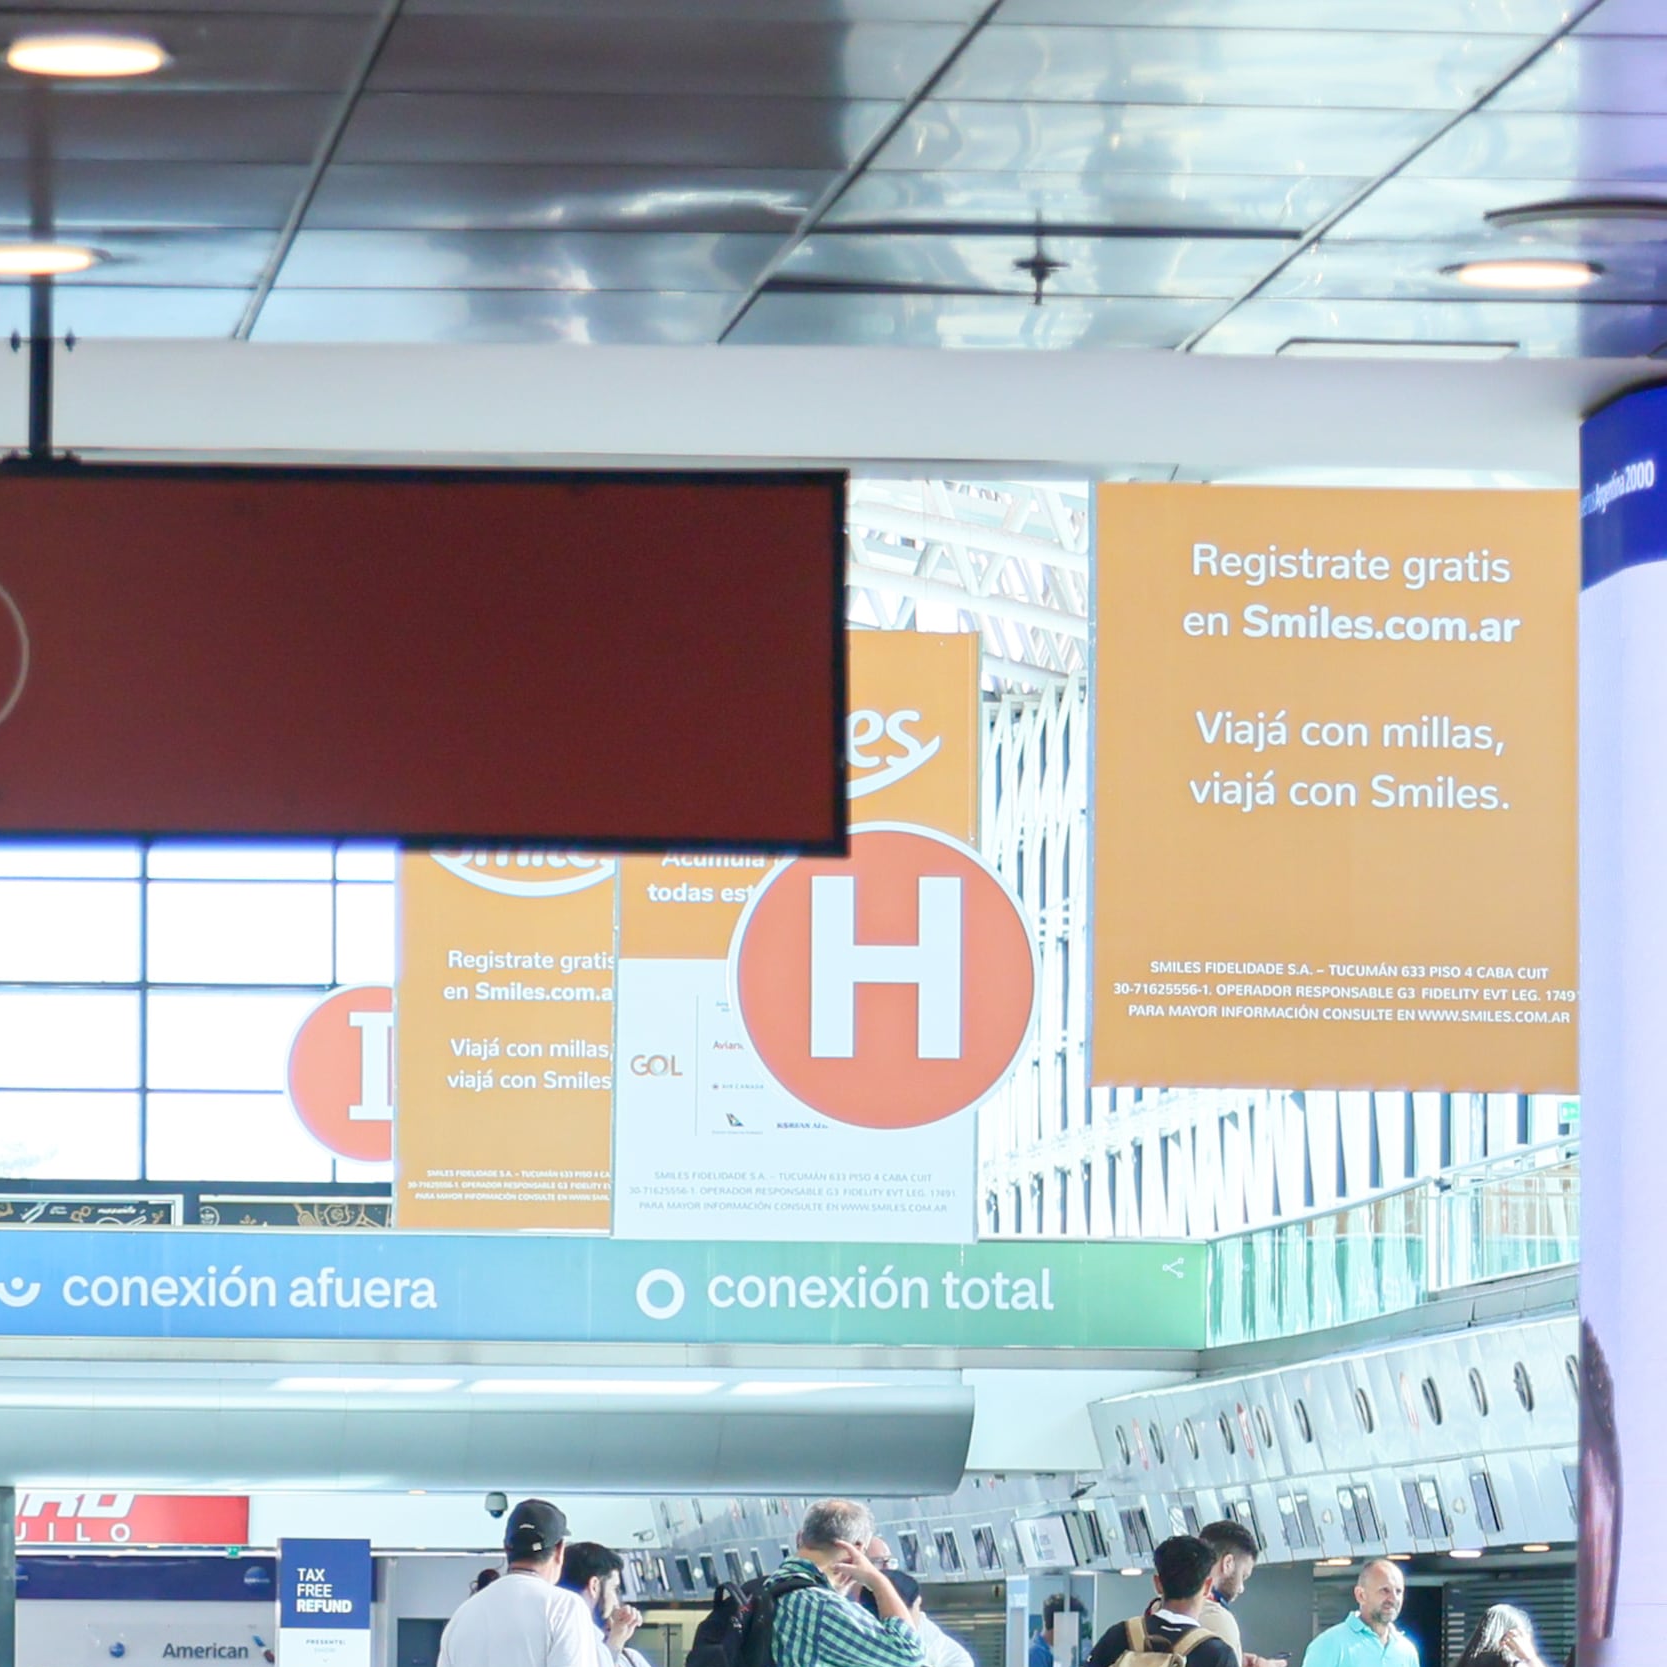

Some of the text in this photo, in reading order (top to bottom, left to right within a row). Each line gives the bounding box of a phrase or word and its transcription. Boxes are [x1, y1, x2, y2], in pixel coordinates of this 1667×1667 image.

[1192, 543, 1510, 589] Registrate gratis
[1183, 605, 1521, 642] en Smiles.com.ar
[1196, 711, 1505, 756] Viajá con millas,
[1190, 770, 1510, 811] viajá con Smiles.
[647, 883, 714, 902] todas
[448, 950, 553, 973] Registrate
[811, 875, 962, 1059] H
[1150, 961, 1549, 979] SMILES FIDELIDADE S.A. TUCUMÁN 633 PISO 4 CABA CUIT
[443, 985, 468, 1000] en
[1128, 1004, 1570, 1023] PARA MAYOR INFORMACIÓN CONSULTE EN WWW.SMILES.COM.AR
[451, 1037, 542, 1060] Viajá con
[630, 1055, 683, 1077] GOL
[447, 1069, 537, 1091] viajá con
[62, 1265, 438, 1309] conexión afuera
[707, 1265, 1054, 1311] conexión total
[297, 1568, 325, 1581] TAX
[297, 1583, 332, 1597] FREE
[296, 1599, 352, 1613] REFUND
[162, 1643, 249, 1659] American
